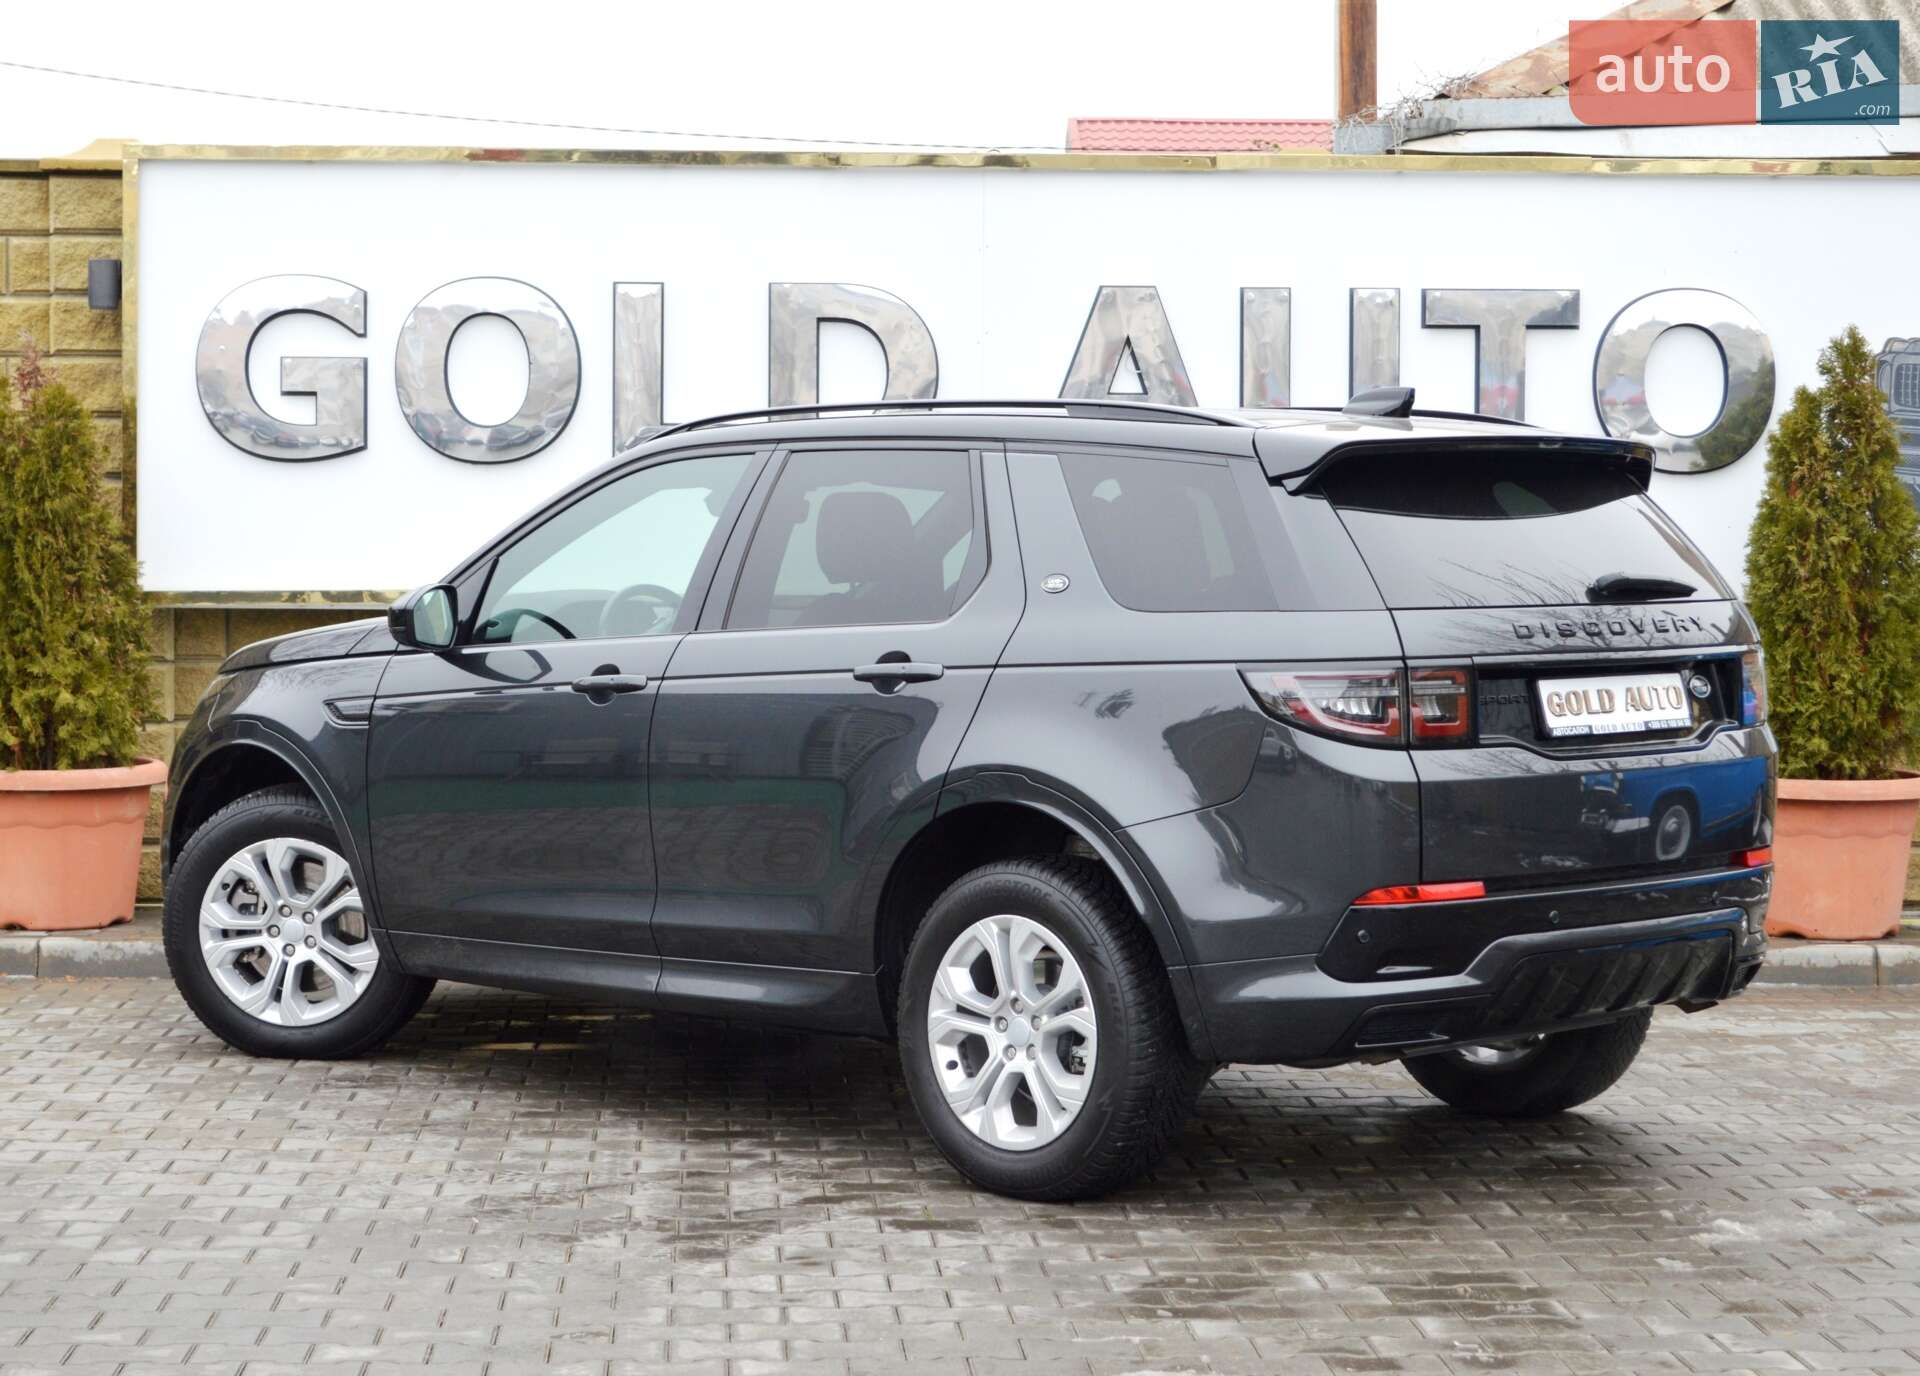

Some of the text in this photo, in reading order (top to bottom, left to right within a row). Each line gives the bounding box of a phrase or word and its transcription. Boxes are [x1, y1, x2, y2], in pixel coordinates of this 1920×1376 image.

[195, 273, 1776, 474] GOLD AUTO
[1512, 615, 1704, 640] DISCOVERY
[1546, 687, 1616, 717] GOLD
[1624, 685, 1684, 712] AUTO
